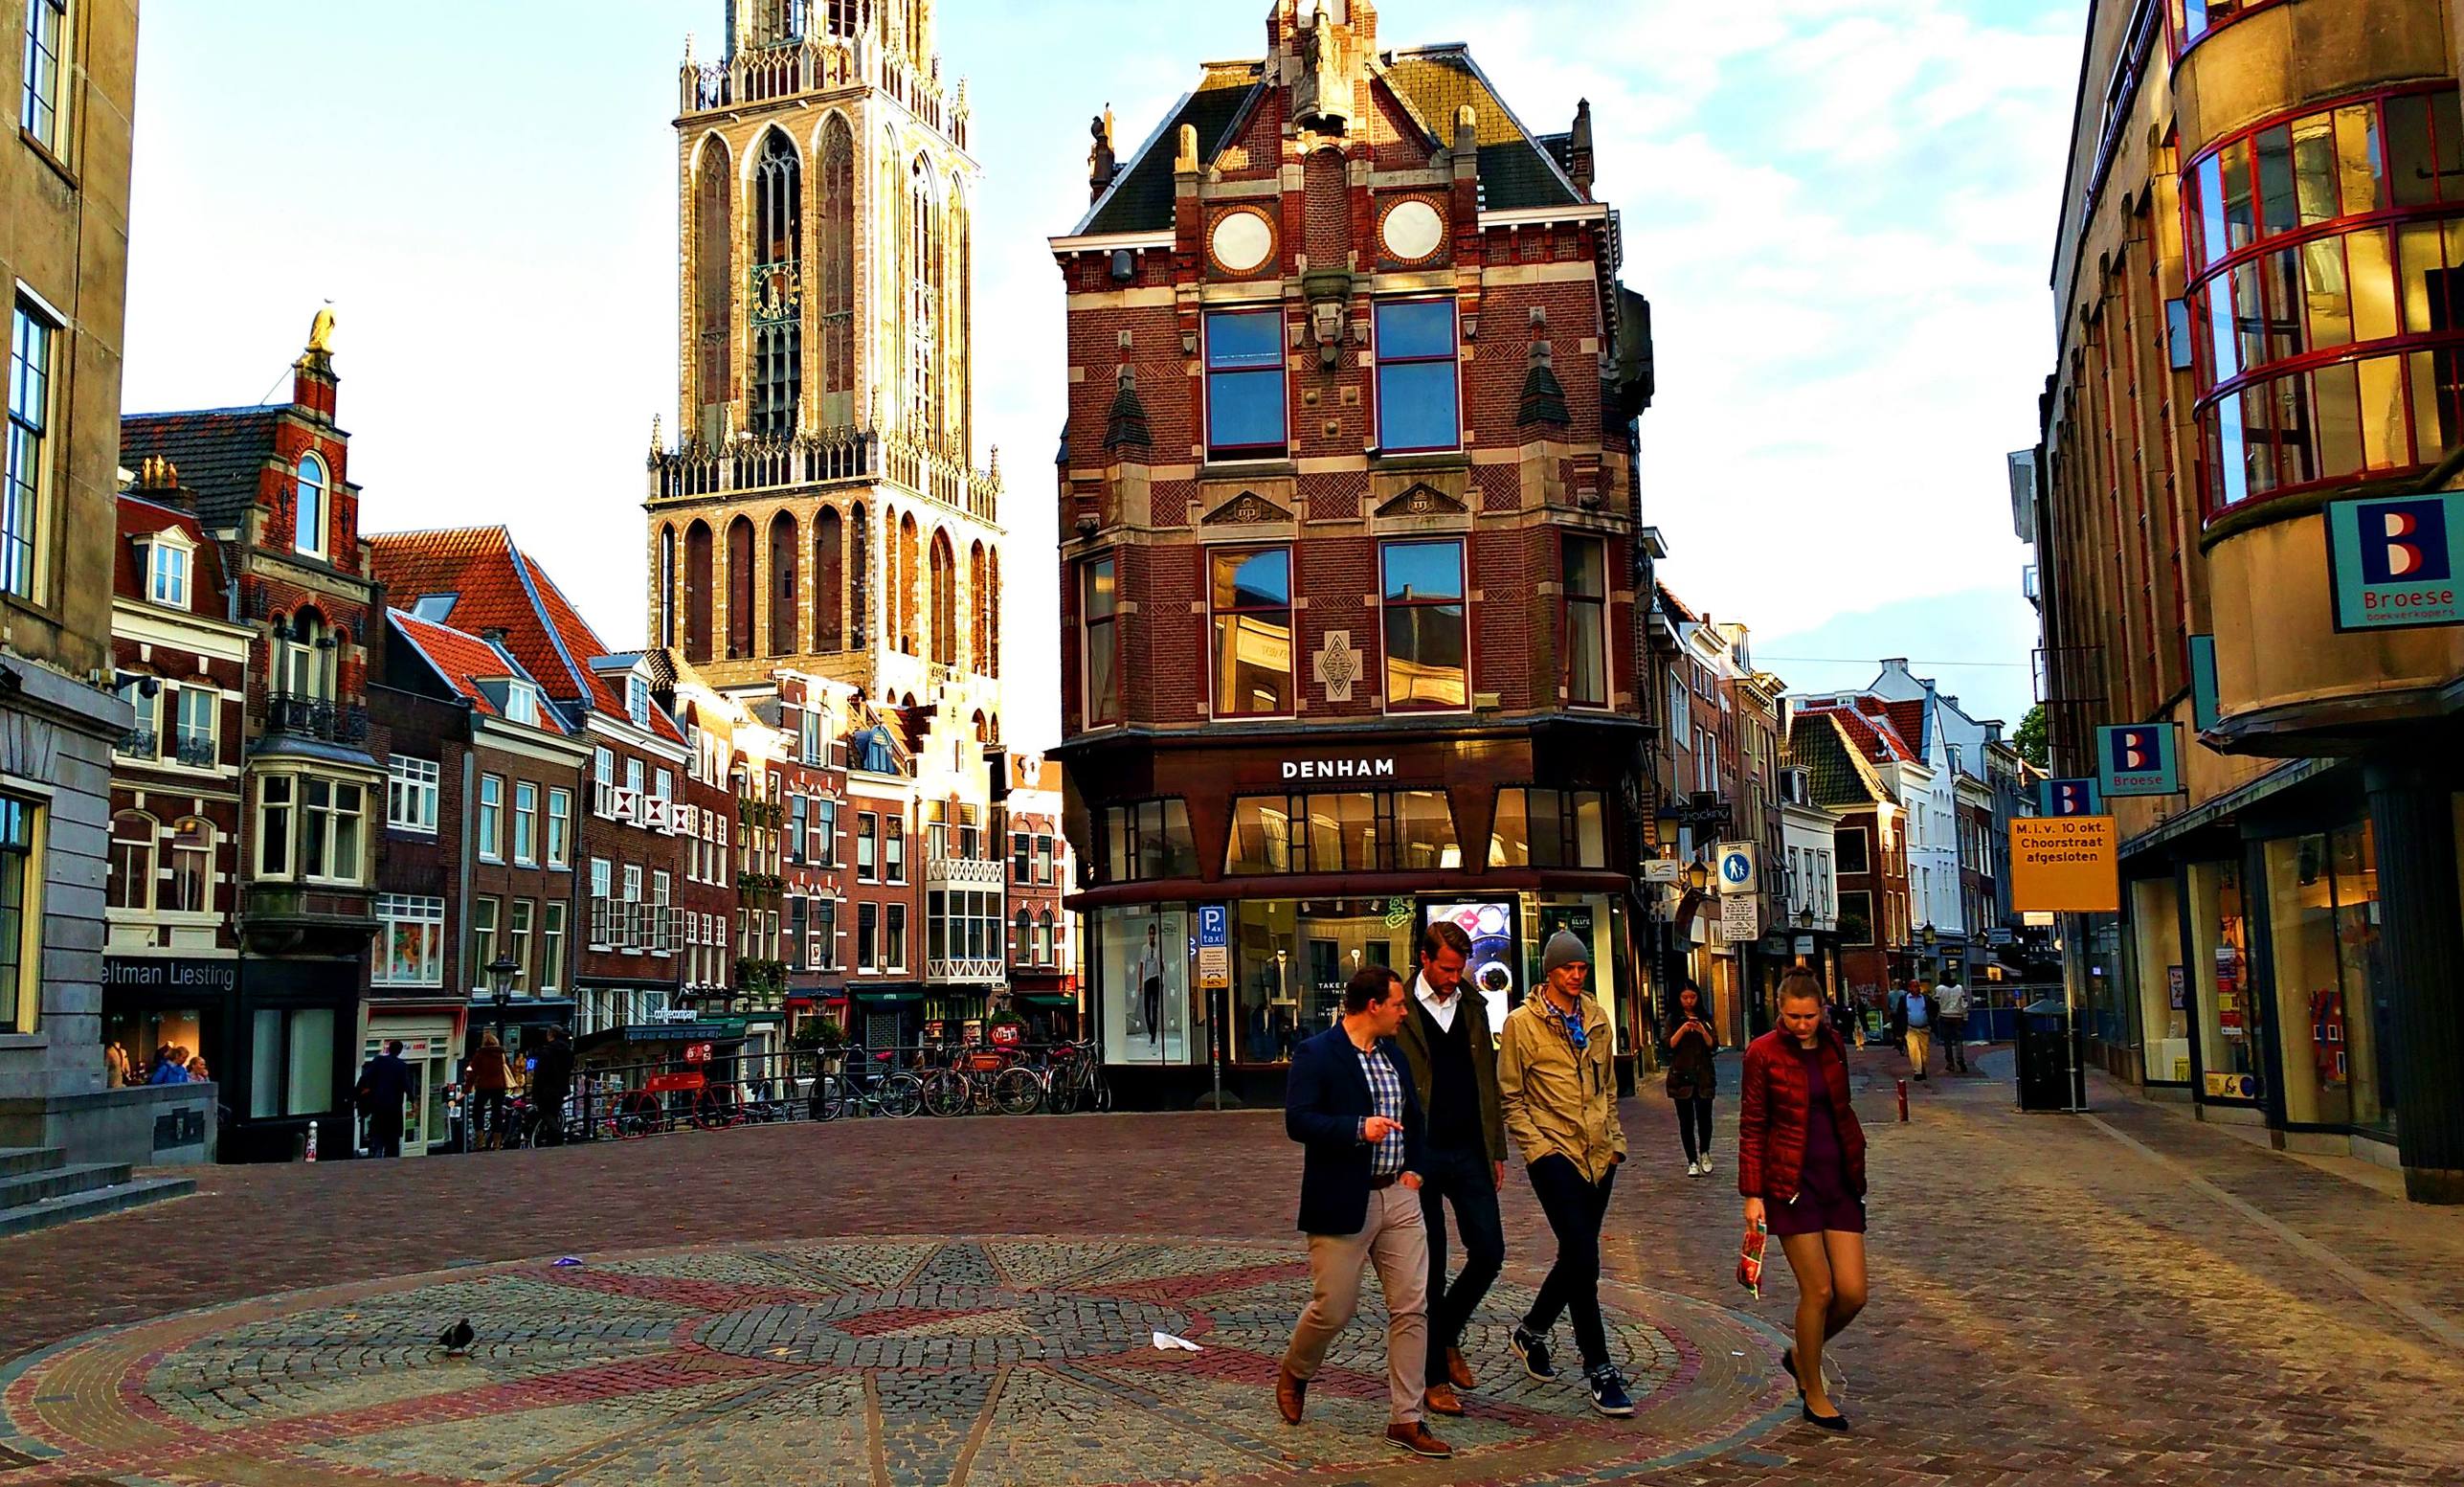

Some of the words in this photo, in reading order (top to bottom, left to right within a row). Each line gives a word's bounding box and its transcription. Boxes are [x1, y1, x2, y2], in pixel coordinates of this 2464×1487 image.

[2363, 590, 2453, 609] Broese
[1282, 758, 1394, 778] DENHAM
[2114, 776, 2162, 786] Broese
[2062, 822, 2075, 833] 10
[2079, 822, 2106, 833] okt.
[2021, 836, 2103, 848] Choorstraat
[2027, 851, 2098, 865] afgesloten
[1205, 910, 1220, 931] P
[1202, 935, 1224, 943] taxi
[101, 960, 162, 984] eltman
[170, 962, 235, 991] Liesting
